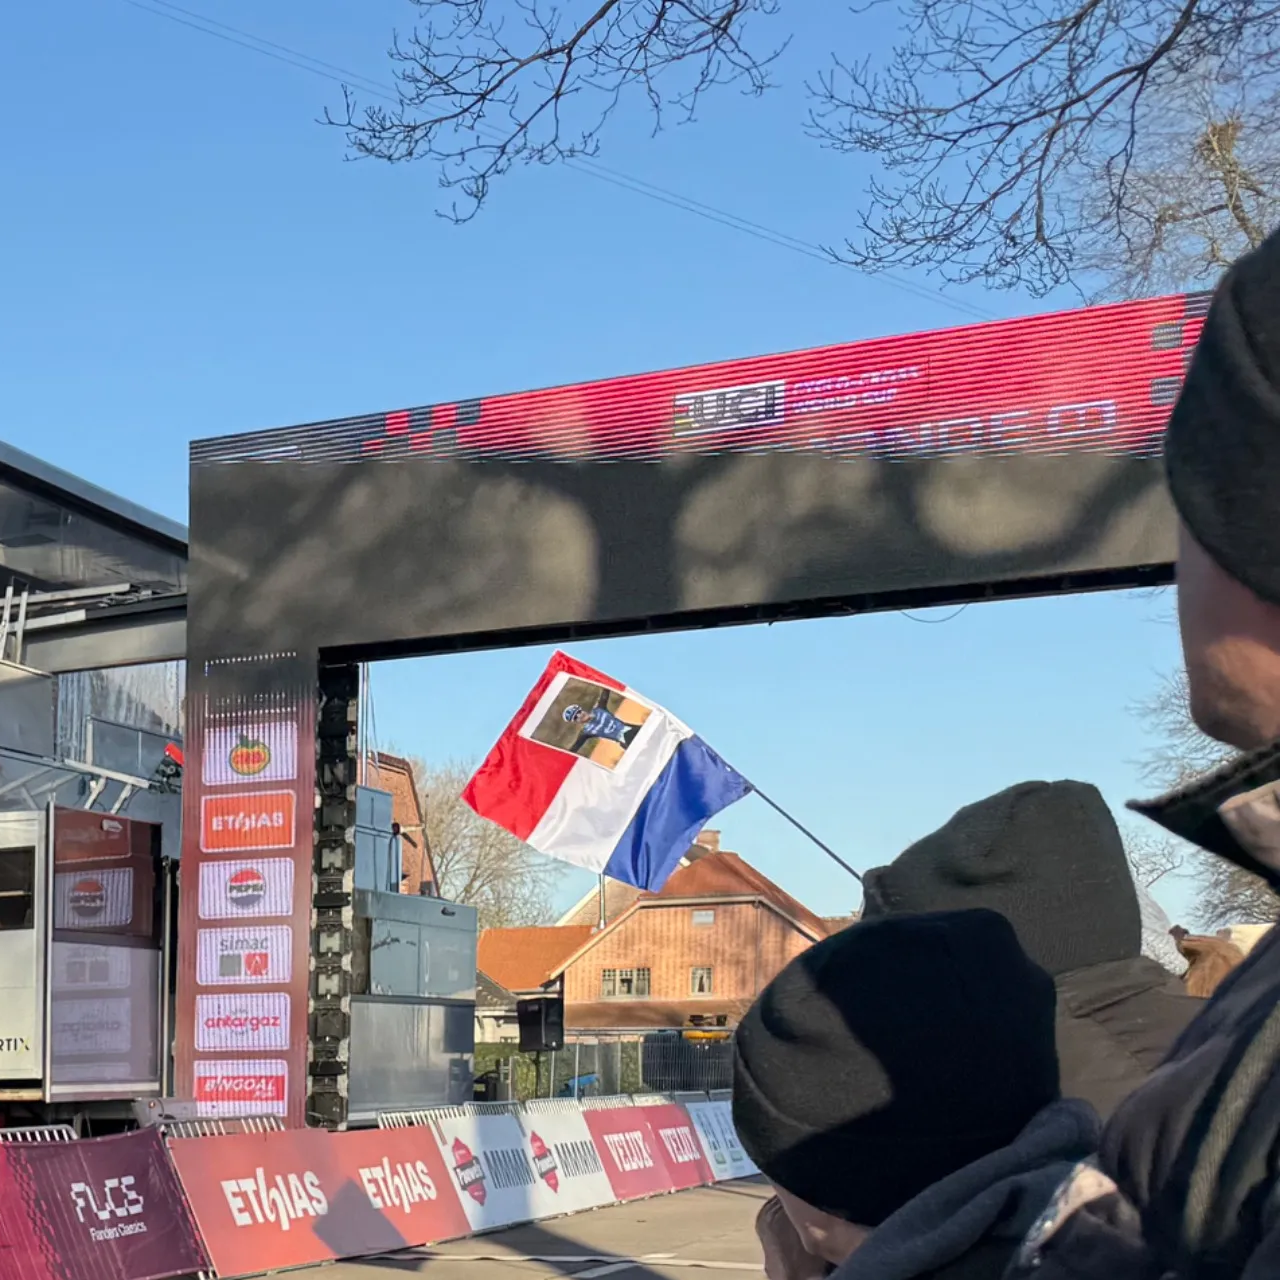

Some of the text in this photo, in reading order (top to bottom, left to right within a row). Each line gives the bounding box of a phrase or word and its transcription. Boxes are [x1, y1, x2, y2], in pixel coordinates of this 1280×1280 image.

[204, 1014, 280, 1031] antargaz
[603, 1130, 653, 1172] VELUX
[659, 1126, 702, 1162] VELUX
